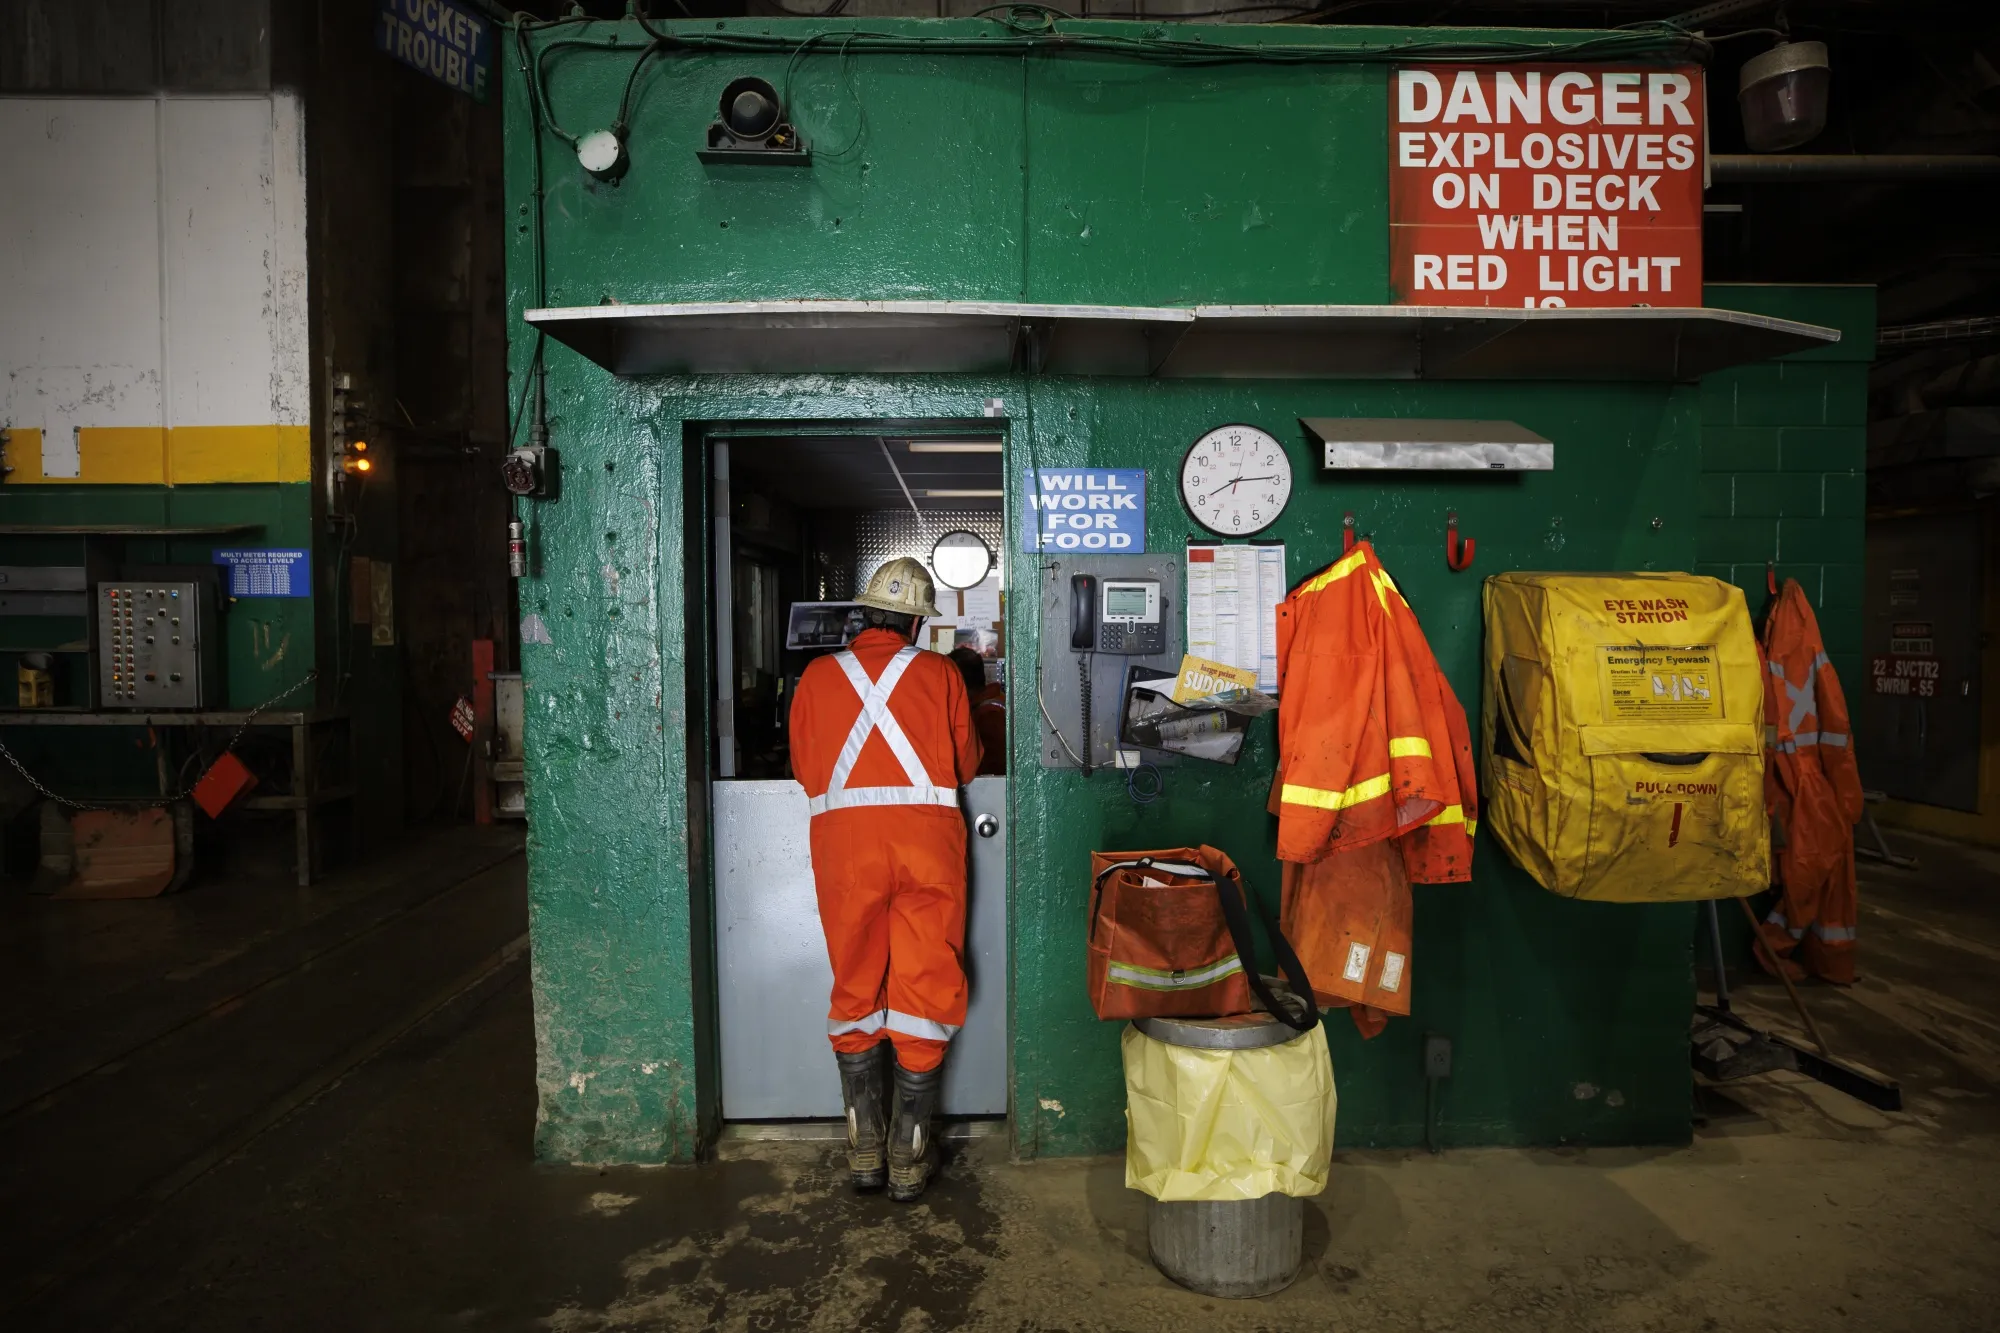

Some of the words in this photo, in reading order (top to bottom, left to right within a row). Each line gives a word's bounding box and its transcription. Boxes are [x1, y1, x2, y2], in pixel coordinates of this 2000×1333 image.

[390, 0, 480, 56] OCKET
[382, 12, 486, 100] TROUBLE
[1398, 70, 1695, 126] DANGER
[1399, 132, 1695, 170] EXPLOSIVES
[1432, 172, 1500, 209] ON
[1533, 174, 1661, 211] DECK
[1478, 214, 1618, 250] WHEN
[1414, 254, 1508, 290] RED
[1539, 256, 1681, 292] LIGHT
[1212, 441, 1221, 452] 11
[1229, 435, 1242, 446] 12
[1254, 441, 1258, 451] 1
[1197, 456, 1209, 467] 10
[1266, 455, 1274, 466] 2
[1041, 474, 1126, 490] WILL
[1192, 476, 1200, 486] 9
[1272, 475, 1280, 486] 3
[1029, 494, 1138, 510] WORK
[1198, 495, 1206, 506] 8
[1267, 494, 1274, 504] 4
[1048, 514, 1118, 529] FOR
[1213, 510, 1220, 520] 7
[1233, 515, 1240, 526] 6
[1252, 510, 1260, 520] 5
[1036, 533, 1131, 548] FOOD
[1604, 600, 1637, 611] EYE
[1639, 599, 1689, 611] WASH
[1616, 610, 1688, 624] STATION
[1666, 656, 1710, 665] Eyewash
[1201, 664, 1218, 675] large
[1218, 670, 1236, 679] print
[1873, 660, 1886, 675] 22
[1895, 660, 1939, 678] SVCTR2
[1876, 677, 1909, 694] SWRM
[1920, 680, 1934, 696] S5
[452, 719, 468, 736] OUT
[454, 710, 473, 731] KEEP
[1636, 782, 1672, 794] PULL
[1677, 783, 1716, 794] DOWN
